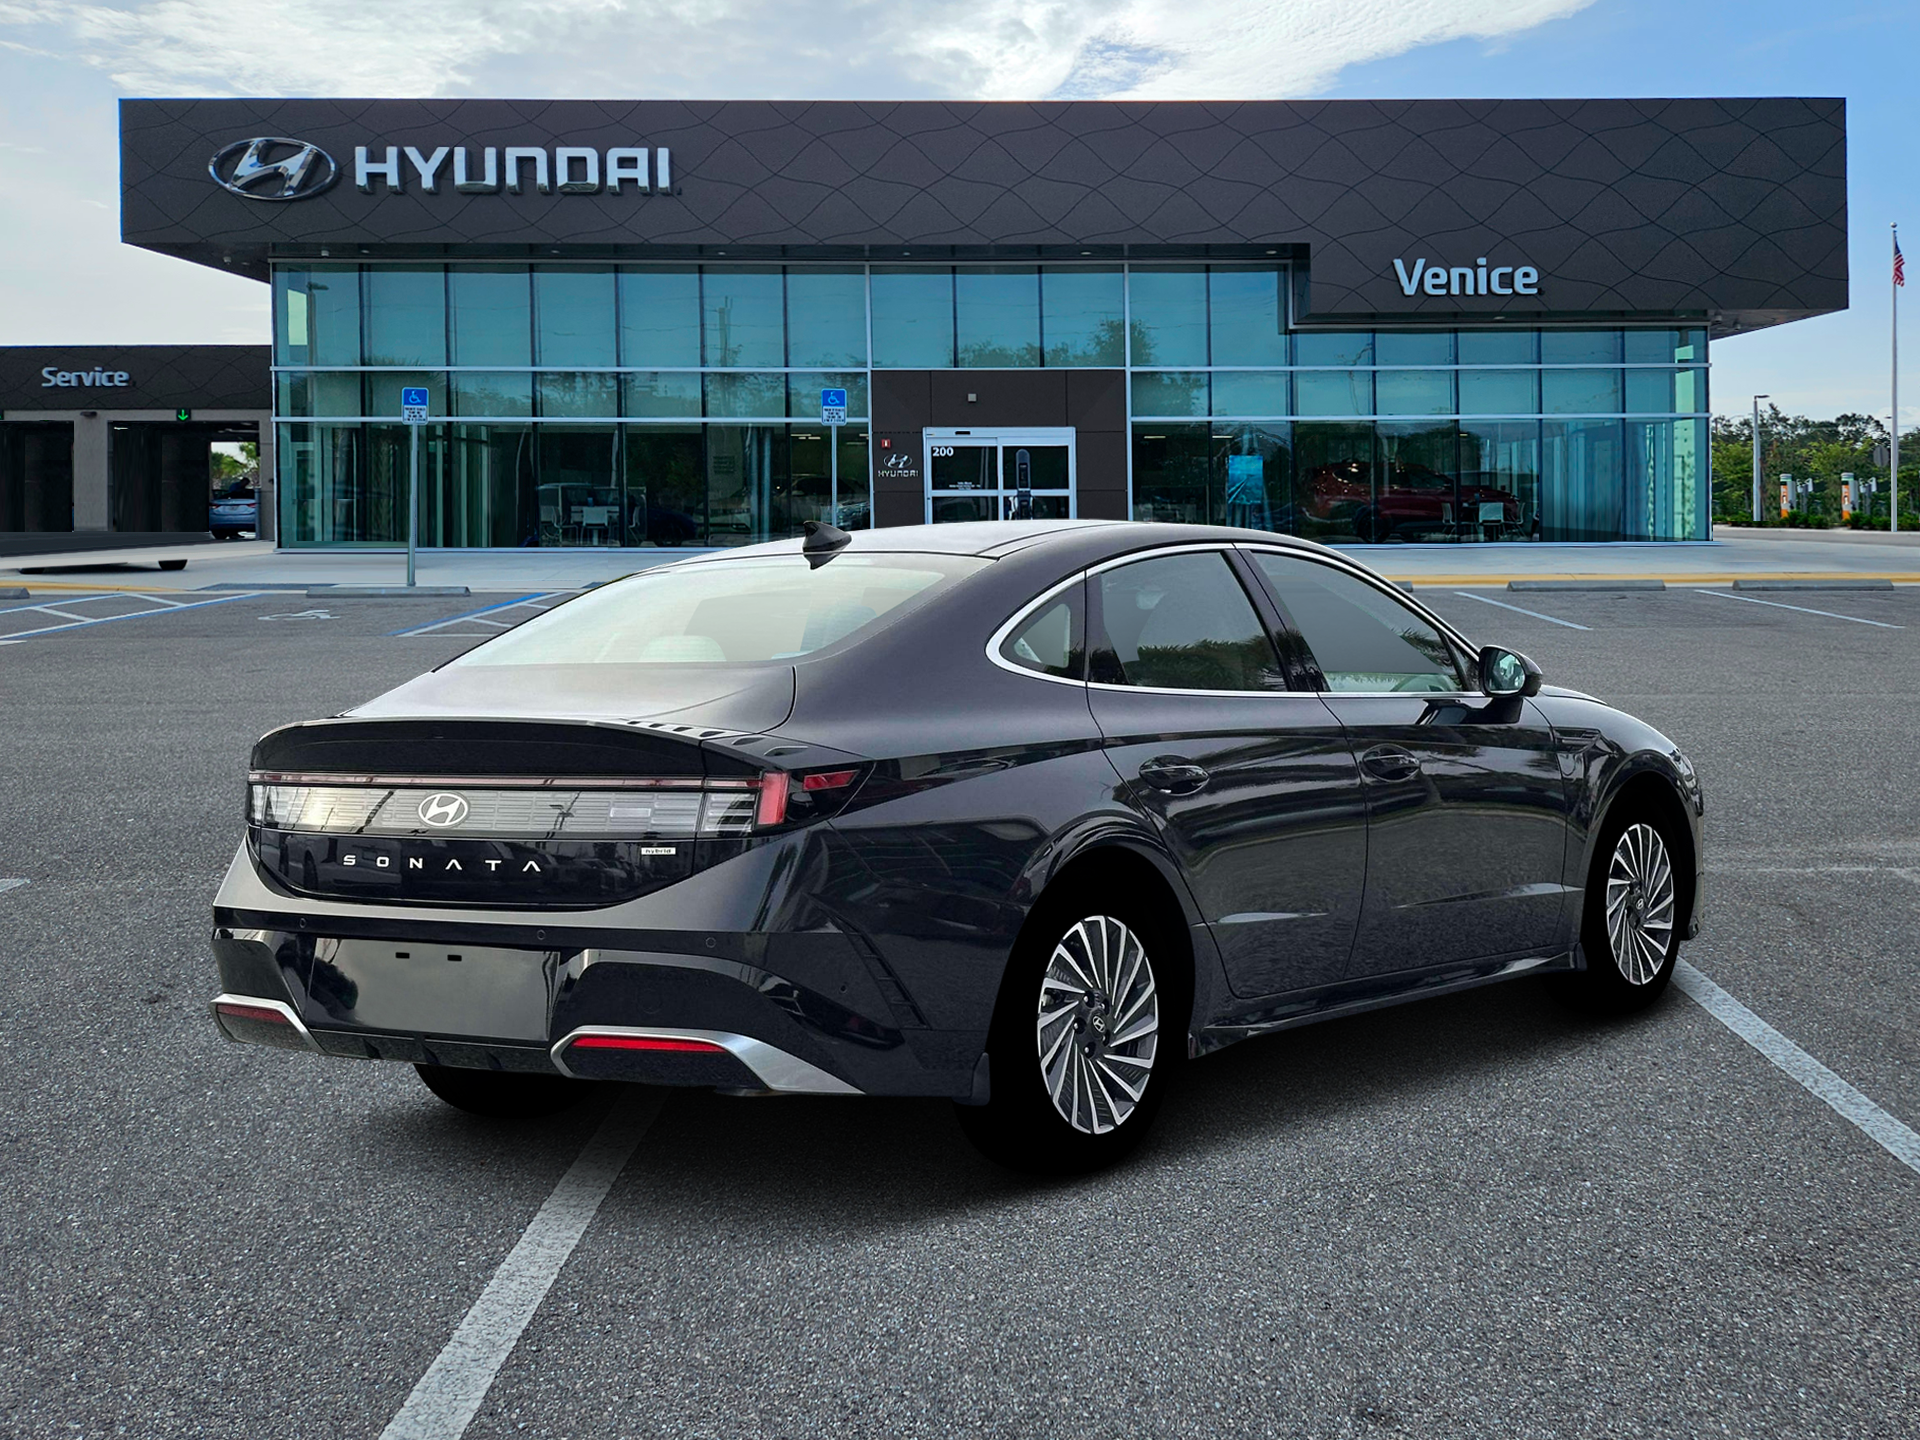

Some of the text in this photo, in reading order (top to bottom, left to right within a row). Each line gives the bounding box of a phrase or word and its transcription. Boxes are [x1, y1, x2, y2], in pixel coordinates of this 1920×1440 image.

[355, 146, 670, 193] HYUNDAI
[1393, 257, 1539, 296] Venice
[41, 366, 130, 387] Service
[932, 446, 954, 457] 200
[343, 855, 541, 872] SONATA
